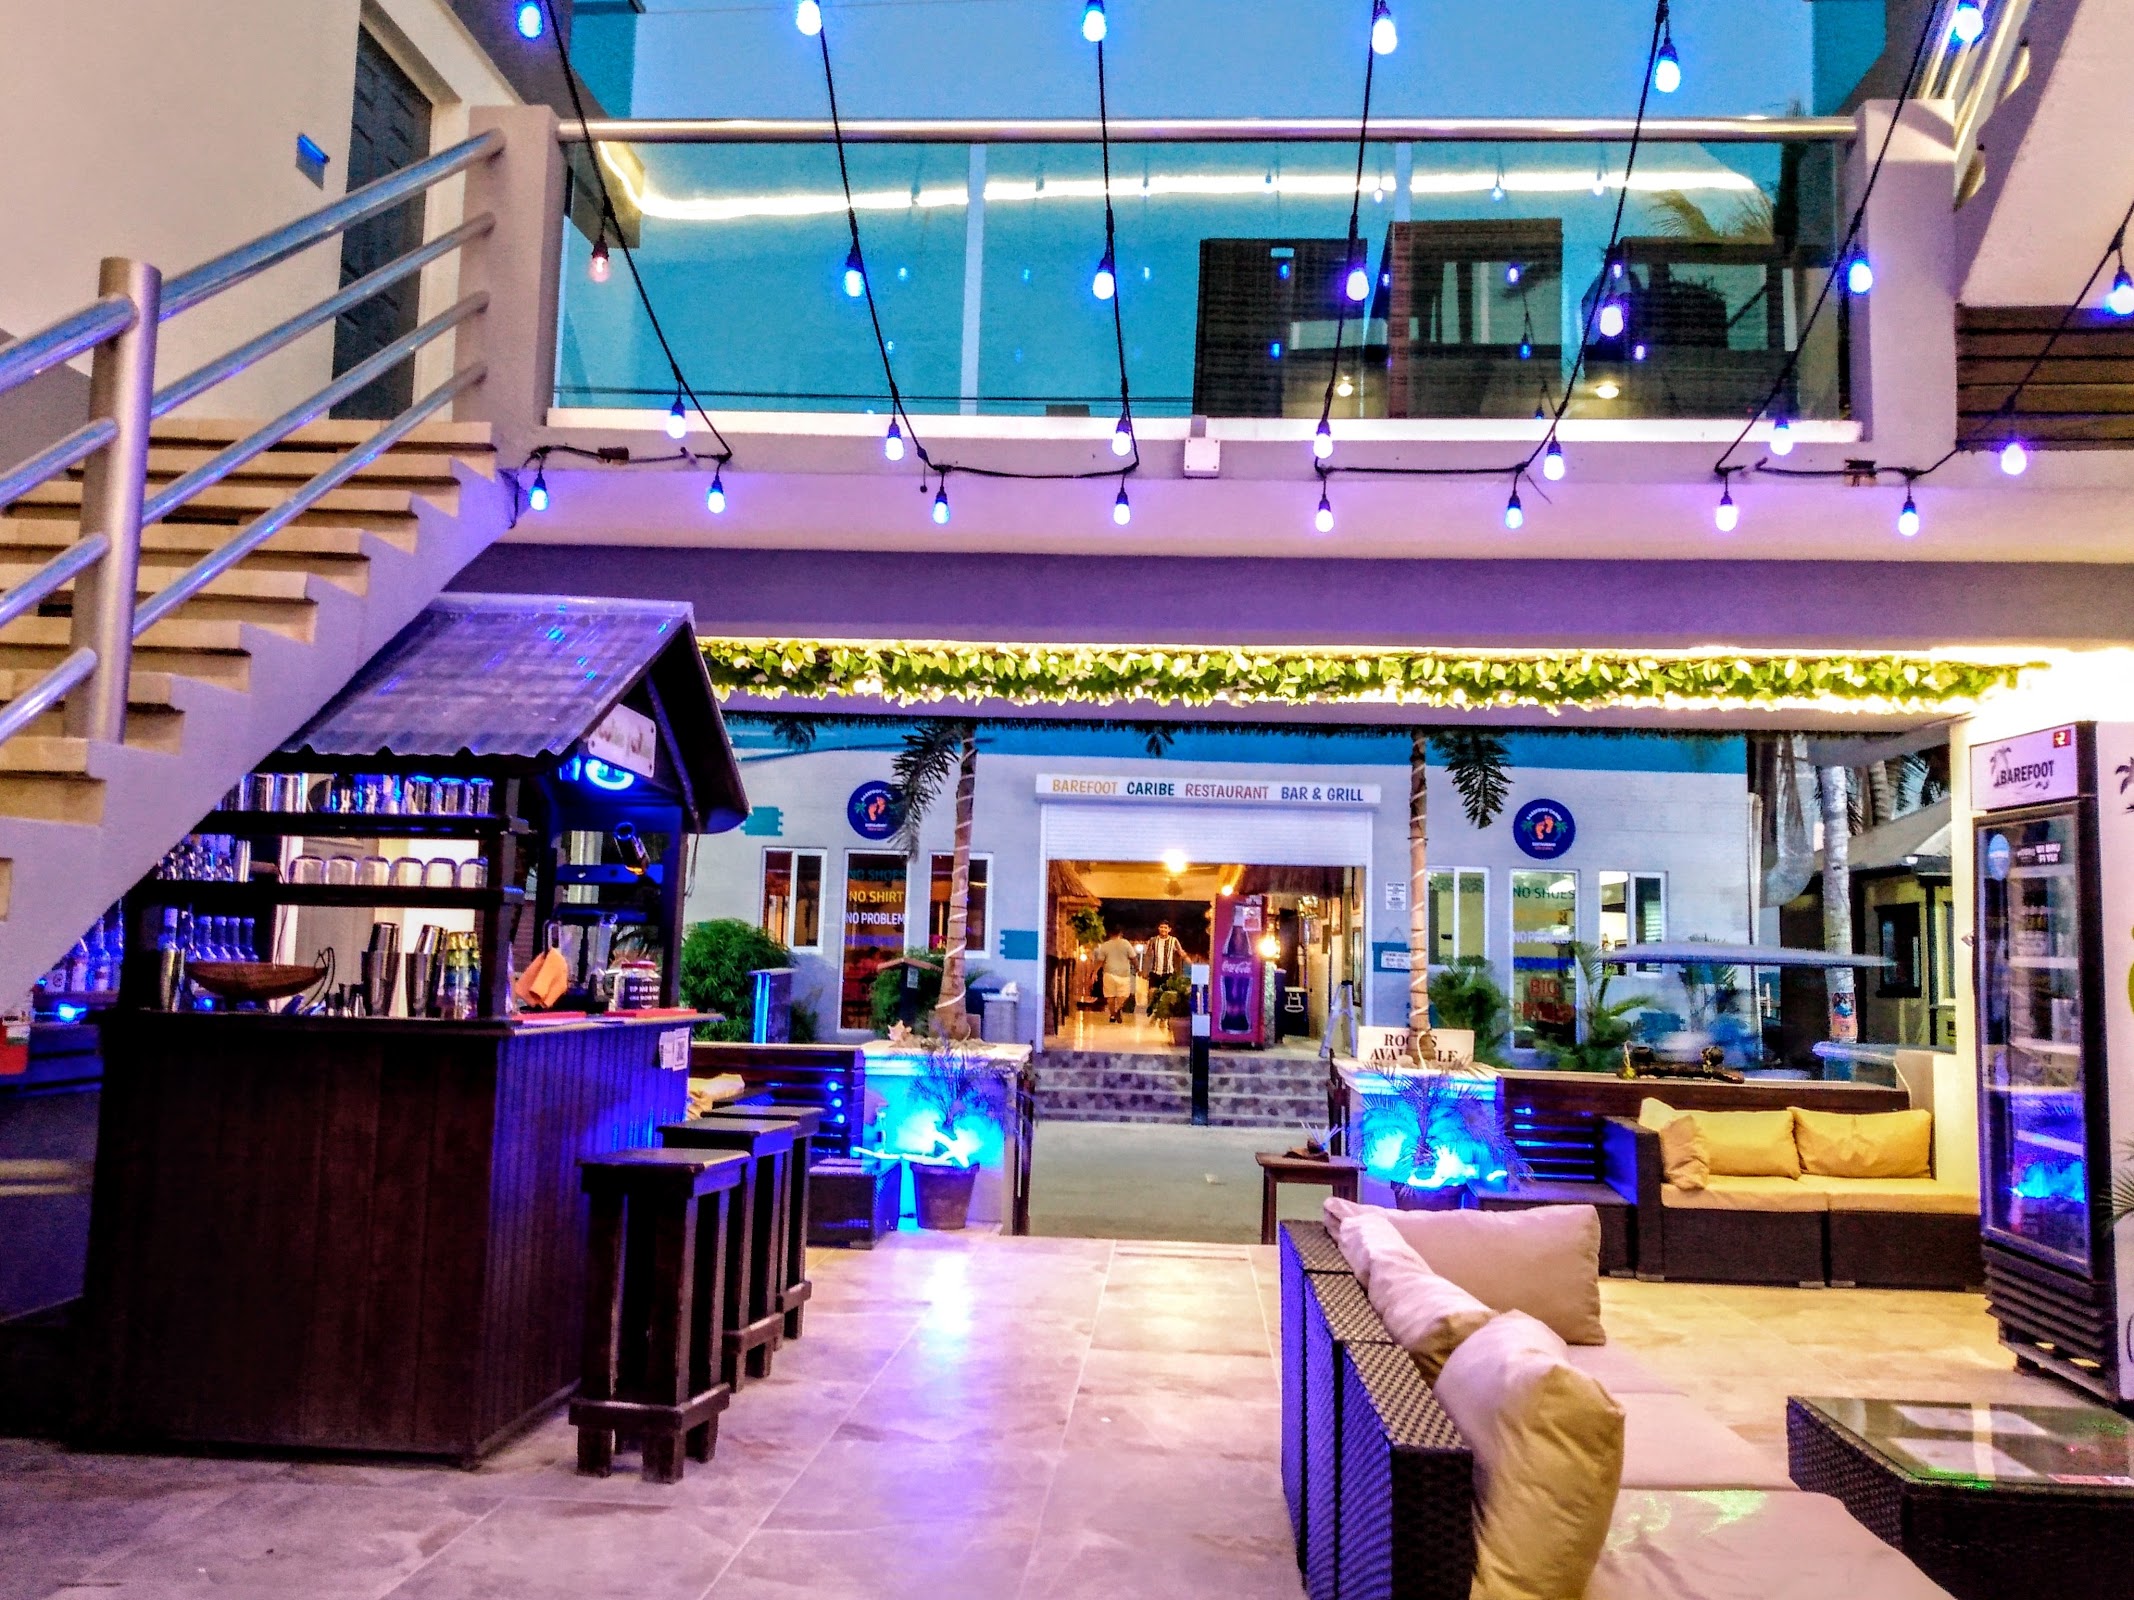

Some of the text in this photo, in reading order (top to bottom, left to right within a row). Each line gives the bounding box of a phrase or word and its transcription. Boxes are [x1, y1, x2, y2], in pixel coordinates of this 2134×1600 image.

[2000, 760, 2054, 784] BAREFOOT
[1052, 779, 1364, 801] BAREFOOT CARIBE RESTAURANT BAR & GRILL
[849, 890, 904, 903] NO SHIRT
[1513, 886, 1531, 898] NO
[846, 911, 905, 925] NO PROBLEM
[1384, 1034, 1438, 1048] ROS
